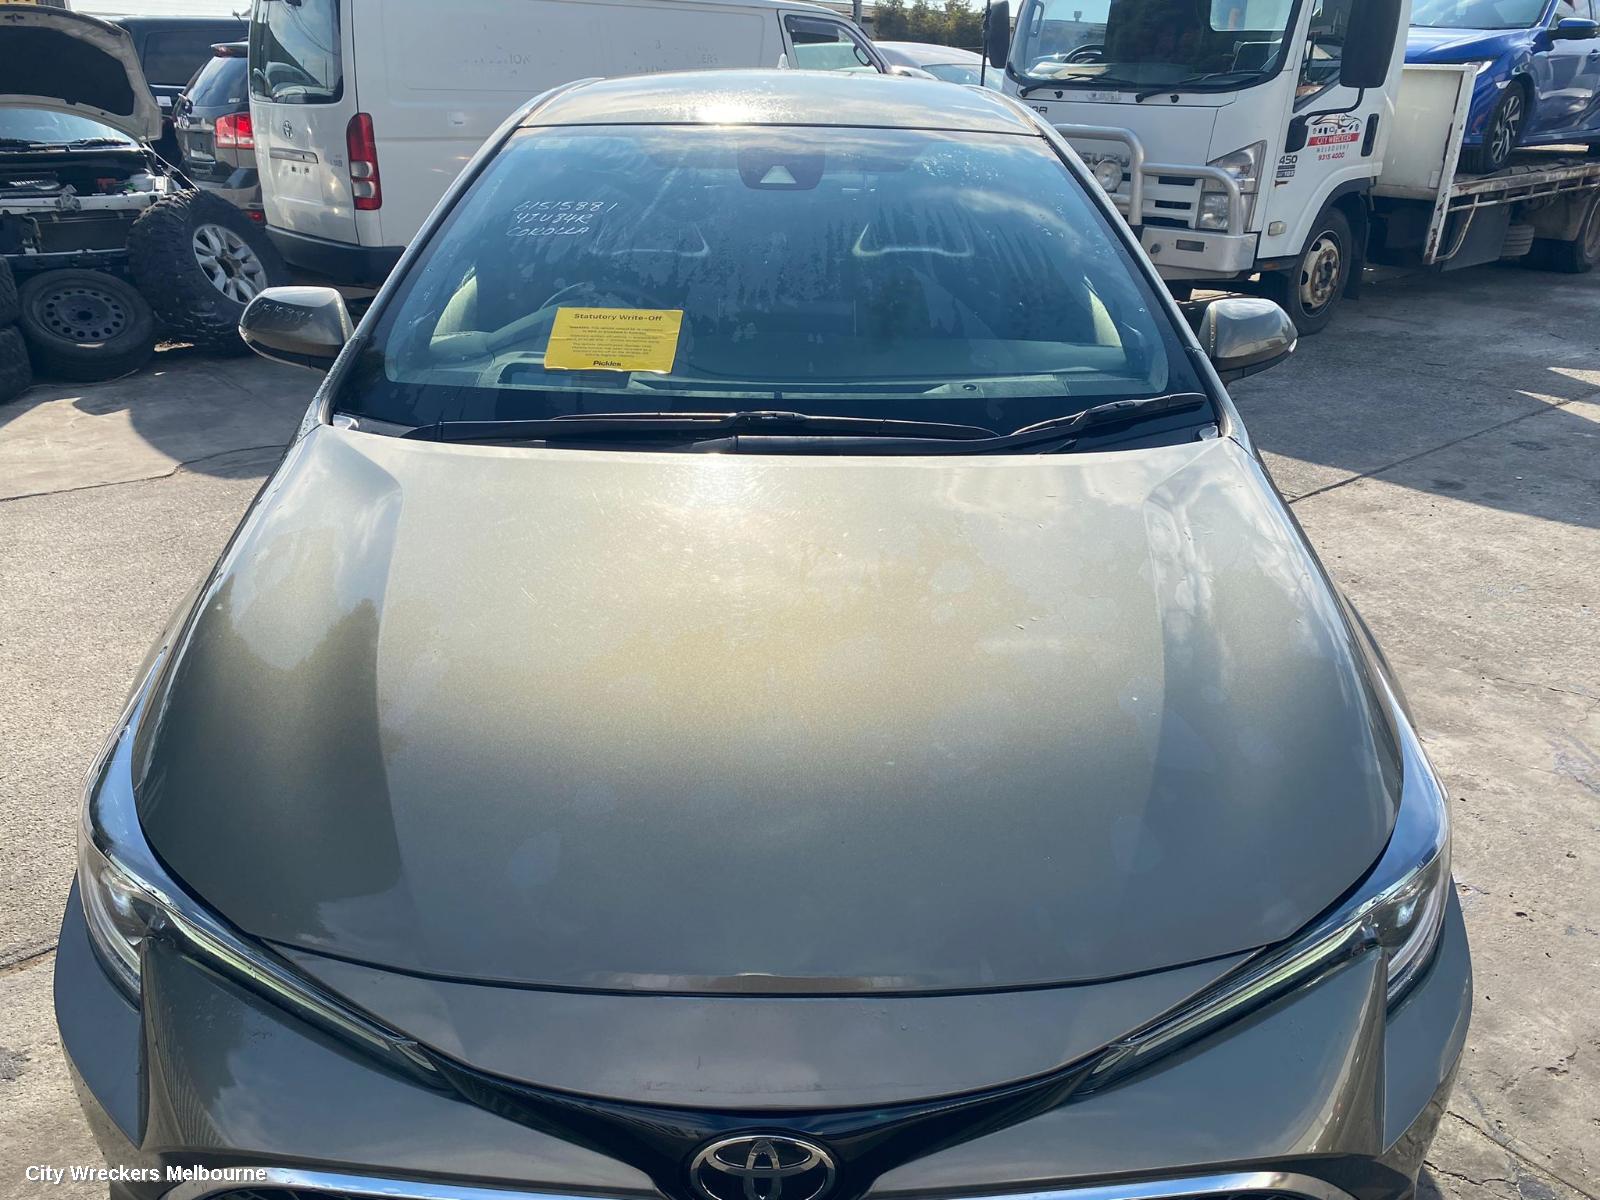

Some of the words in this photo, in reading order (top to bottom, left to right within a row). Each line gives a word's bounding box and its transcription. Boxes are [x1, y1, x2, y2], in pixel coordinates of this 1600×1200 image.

[1279, 155, 1298, 164] 450
[574, 313, 617, 321] Statutory
[619, 313, 663, 321] Write-Off
